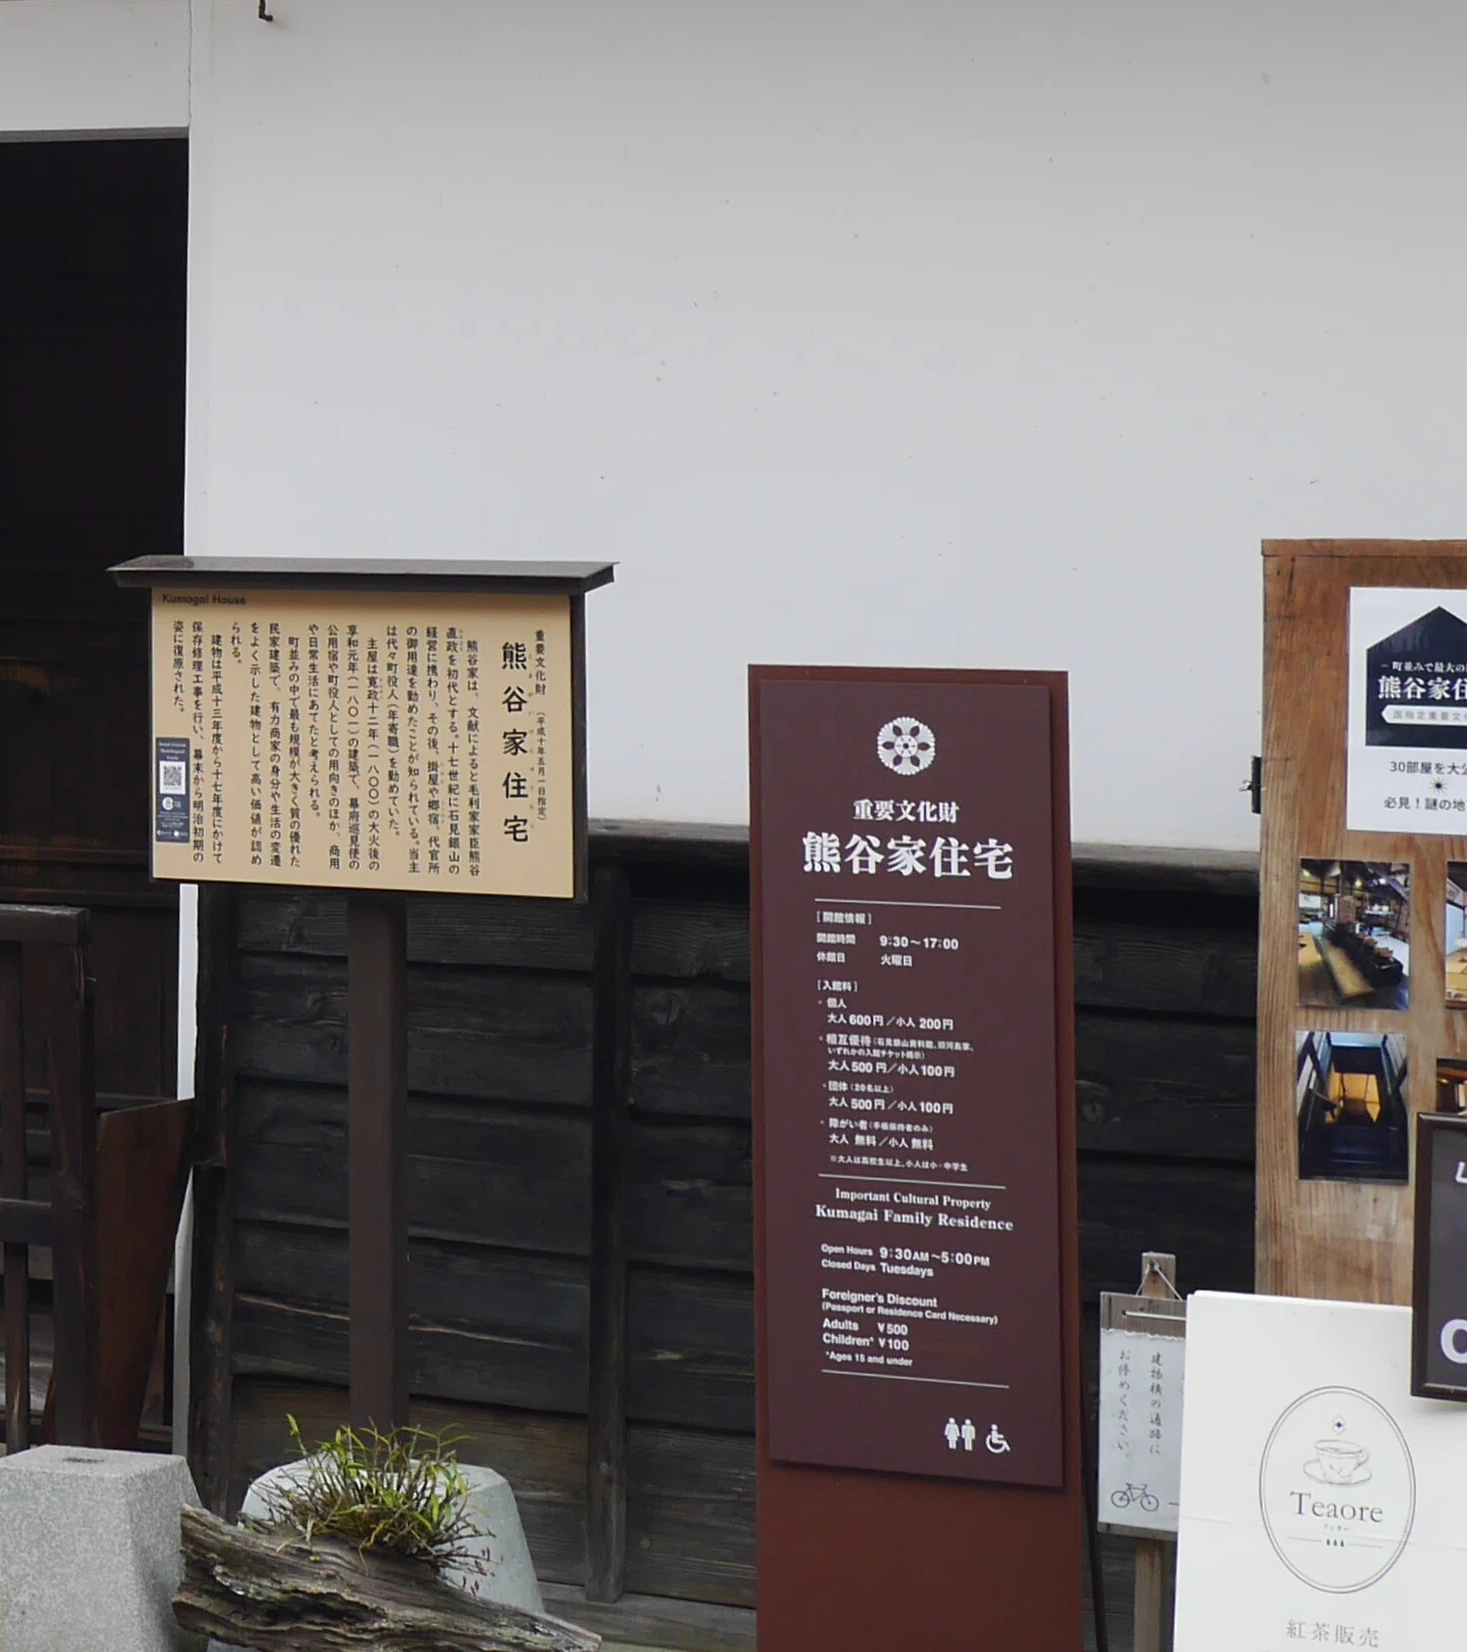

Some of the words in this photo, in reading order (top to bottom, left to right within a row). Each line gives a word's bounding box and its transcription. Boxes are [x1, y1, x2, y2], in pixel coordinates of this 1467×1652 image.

[213, 595, 247, 605] House
[231, 621, 243, 664] られる。
[173, 621, 185, 712] 姿に復原された。
[534, 629, 547, 696] 重要文化財
[1392, 661, 1467, 674] 町並みで最大の
[501, 641, 529, 844] 熊谷家住宅
[852, 798, 960, 824] 重要文化財
[802, 831, 1013, 880] 熊谷家住宅
[816, 933, 856, 945] 開館時間
[816, 952, 846, 963] 休館日
[881, 954, 913, 967] 火曜日
[835, 1187, 890, 1202] Important
[893, 1192, 939, 1206] Cultural
[943, 1196, 992, 1211] Property
[815, 1204, 879, 1223] Kumagai
[883, 1209, 933, 1227] Family
[938, 1213, 1014, 1231] Residence
[821, 1244, 844, 1256] Open
[846, 1245, 873, 1257] Hours
[821, 1259, 853, 1271] Closed
[853, 1261, 876, 1273] Days
[879, 1262, 934, 1278] Tuesdays
[886, 1293, 938, 1308] Discount
[821, 1302, 864, 1316] (Passport
[866, 1306, 875, 1315] or
[877, 1305, 923, 1319] Residence
[924, 1309, 947, 1321] Card
[948, 1311, 999, 1326] Necessary)
[822, 1318, 859, 1332] Adults
[854, 1353, 866, 1363] 15
[867, 1354, 885, 1364] and
[886, 1356, 914, 1367] under
[1289, 1491, 1384, 1524] Teaore
[1285, 1619, 1380, 1649] 紅茶販売
